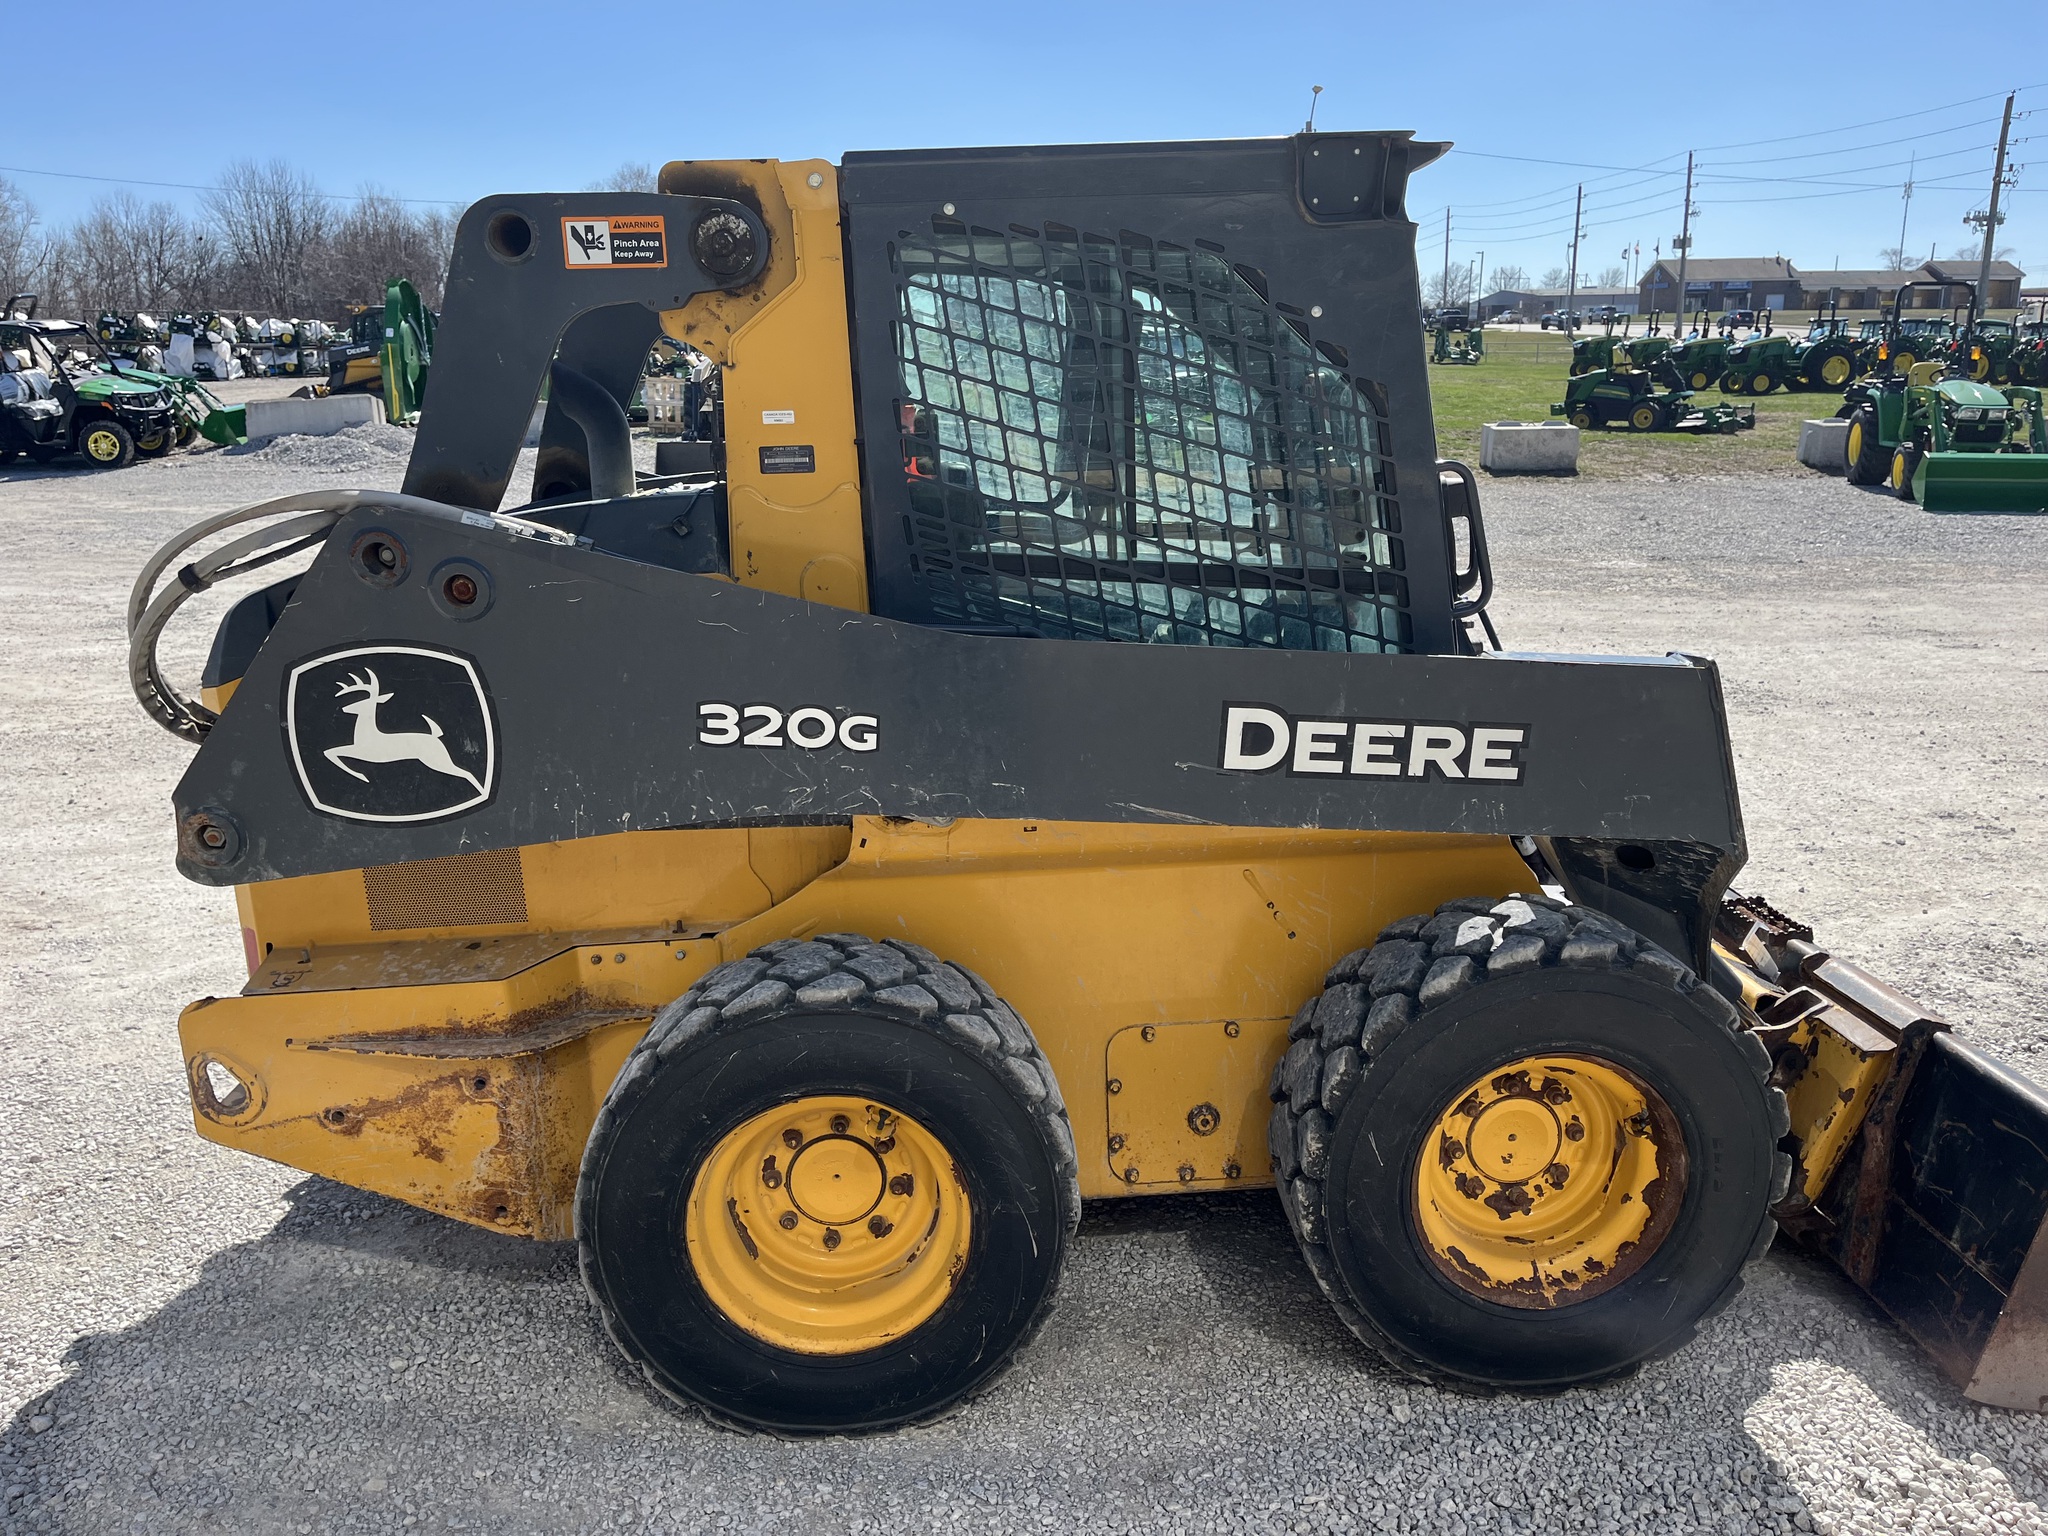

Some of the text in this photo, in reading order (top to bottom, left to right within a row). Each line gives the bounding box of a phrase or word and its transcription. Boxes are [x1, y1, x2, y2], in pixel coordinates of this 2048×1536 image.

[639, 239, 660, 247] Area
[634, 250, 654, 258] Away
[346, 346, 370, 355] DEERE
[699, 703, 878, 752] 320G
[1223, 707, 1525, 780] DEERE
